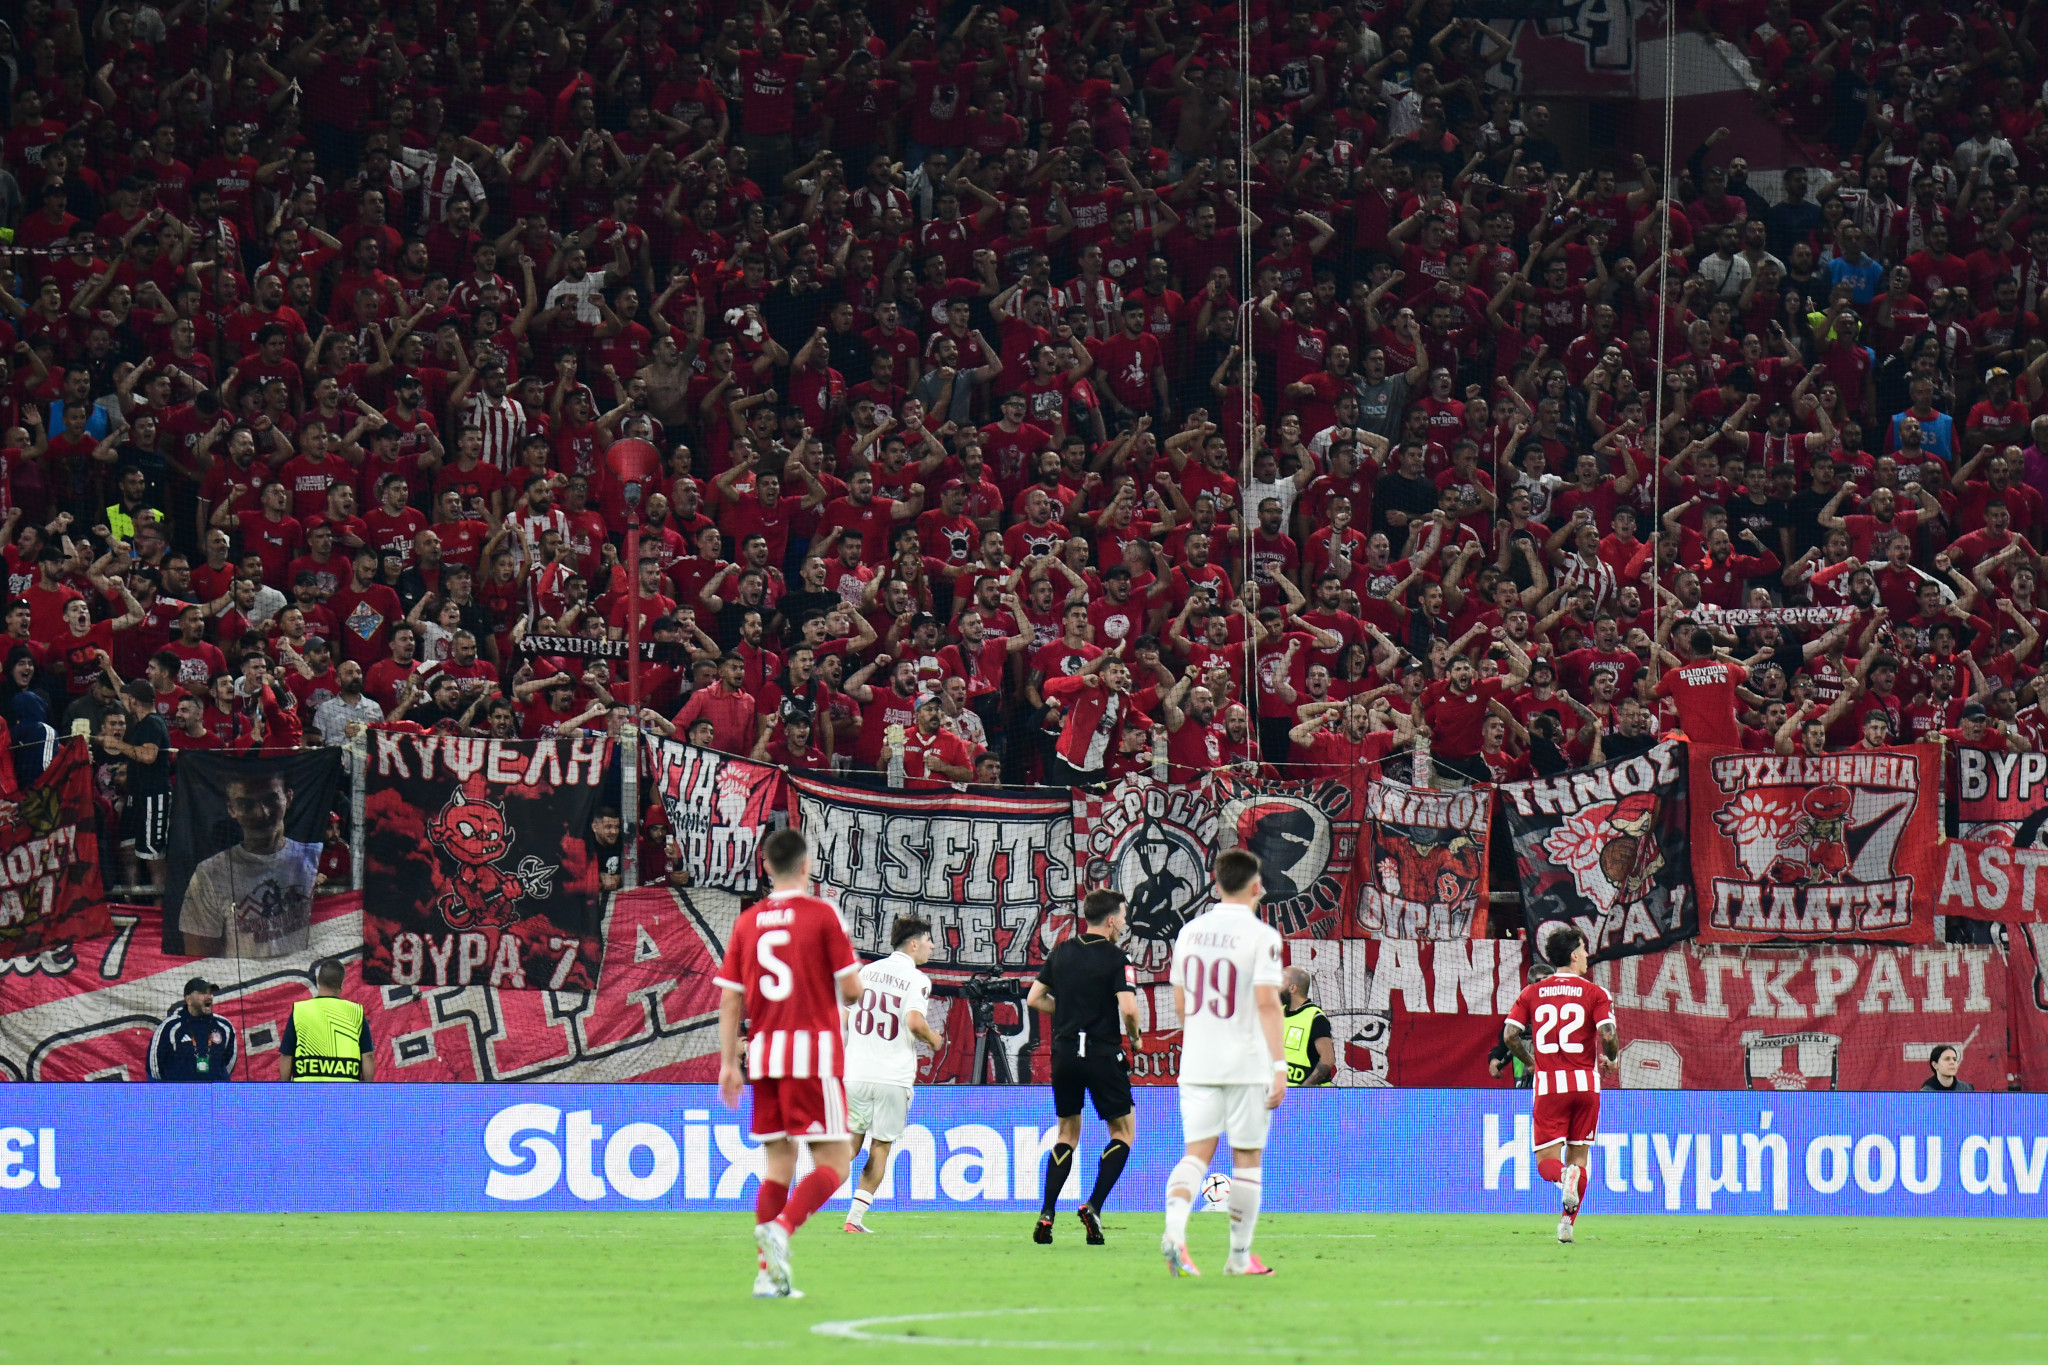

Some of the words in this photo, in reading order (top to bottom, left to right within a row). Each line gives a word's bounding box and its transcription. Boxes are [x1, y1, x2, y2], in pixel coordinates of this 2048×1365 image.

[1430, 416, 1459, 425] SYROS
[1505, 739, 1682, 817] ΤΗΝΟΣ
[1959, 747, 2048, 801] ΒΥΡ
[801, 795, 1077, 904] MISFITS
[1848, 787, 1915, 881] 7
[1713, 882, 1911, 931] ΓΑΛΑΤΣΙ
[391, 932, 527, 989] ΘΥΡΑ
[549, 936, 580, 990] 7
[756, 929, 793, 1001] 5
[1186, 931, 1241, 950] PRELEC
[1182, 953, 1237, 1019] 99
[1538, 985, 1583, 998] CHIQUINHO
[855, 988, 902, 1041] 85
[1534, 1002, 1586, 1054] 22
[295, 1058, 359, 1076] STEWARD
[485, 1103, 1080, 1201] Stoixman
[1552, 1110, 1788, 1210] τιγμή
[1805, 1134, 1942, 1194] σου
[1959, 1135, 2048, 1195] αν
